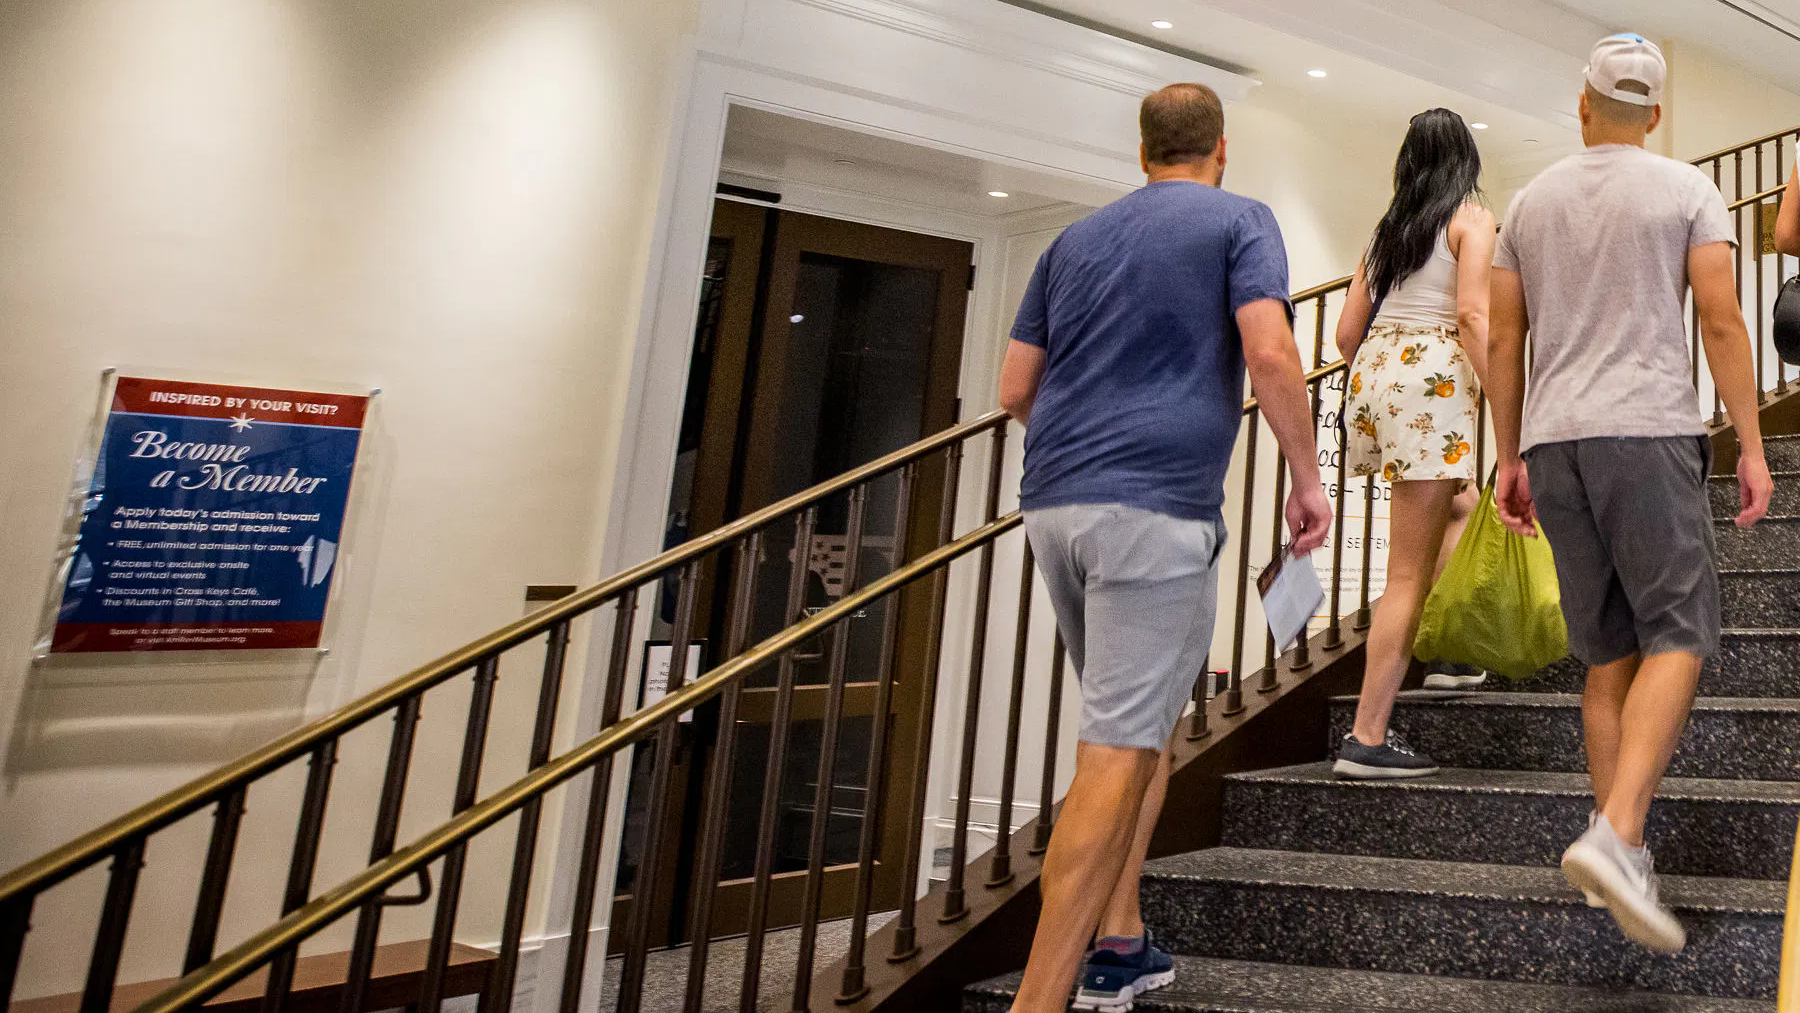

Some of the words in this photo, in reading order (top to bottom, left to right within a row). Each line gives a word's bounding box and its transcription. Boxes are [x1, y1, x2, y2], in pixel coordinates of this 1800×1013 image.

[150, 391, 222, 407] INSPIRED
[225, 397, 247, 408] BY
[250, 399, 292, 412] YOUR
[295, 402, 339, 415] VISIT?
[129, 430, 251, 463] Become
[150, 470, 176, 488] a
[177, 463, 328, 495] Member
[114, 506, 157, 517] Apply
[159, 507, 209, 519] today's
[210, 510, 275, 520] admission
[277, 511, 320, 522] toward
[111, 521, 122, 529] a
[124, 519, 209, 532] Membership
[210, 523, 238, 532] and
[240, 524, 291, 533] receive:
[198, 542, 251, 551] admission
[252, 543, 267, 551] for
[269, 544, 290, 552] one
[112, 560, 152, 568] Access
[167, 560, 217, 569] exclusive
[219, 561, 250, 569] onsite
[108, 571, 134, 579] and
[136, 571, 171, 579] virtual
[171, 572, 207, 580] events
[105, 587, 160, 595] Discounts
[160, 587, 173, 595] in
[174, 587, 204, 595] Cross
[103, 598, 123, 606] the
[124, 598, 172, 606] Museum
[174, 598, 194, 606] Gift
[227, 598, 249, 606] and
